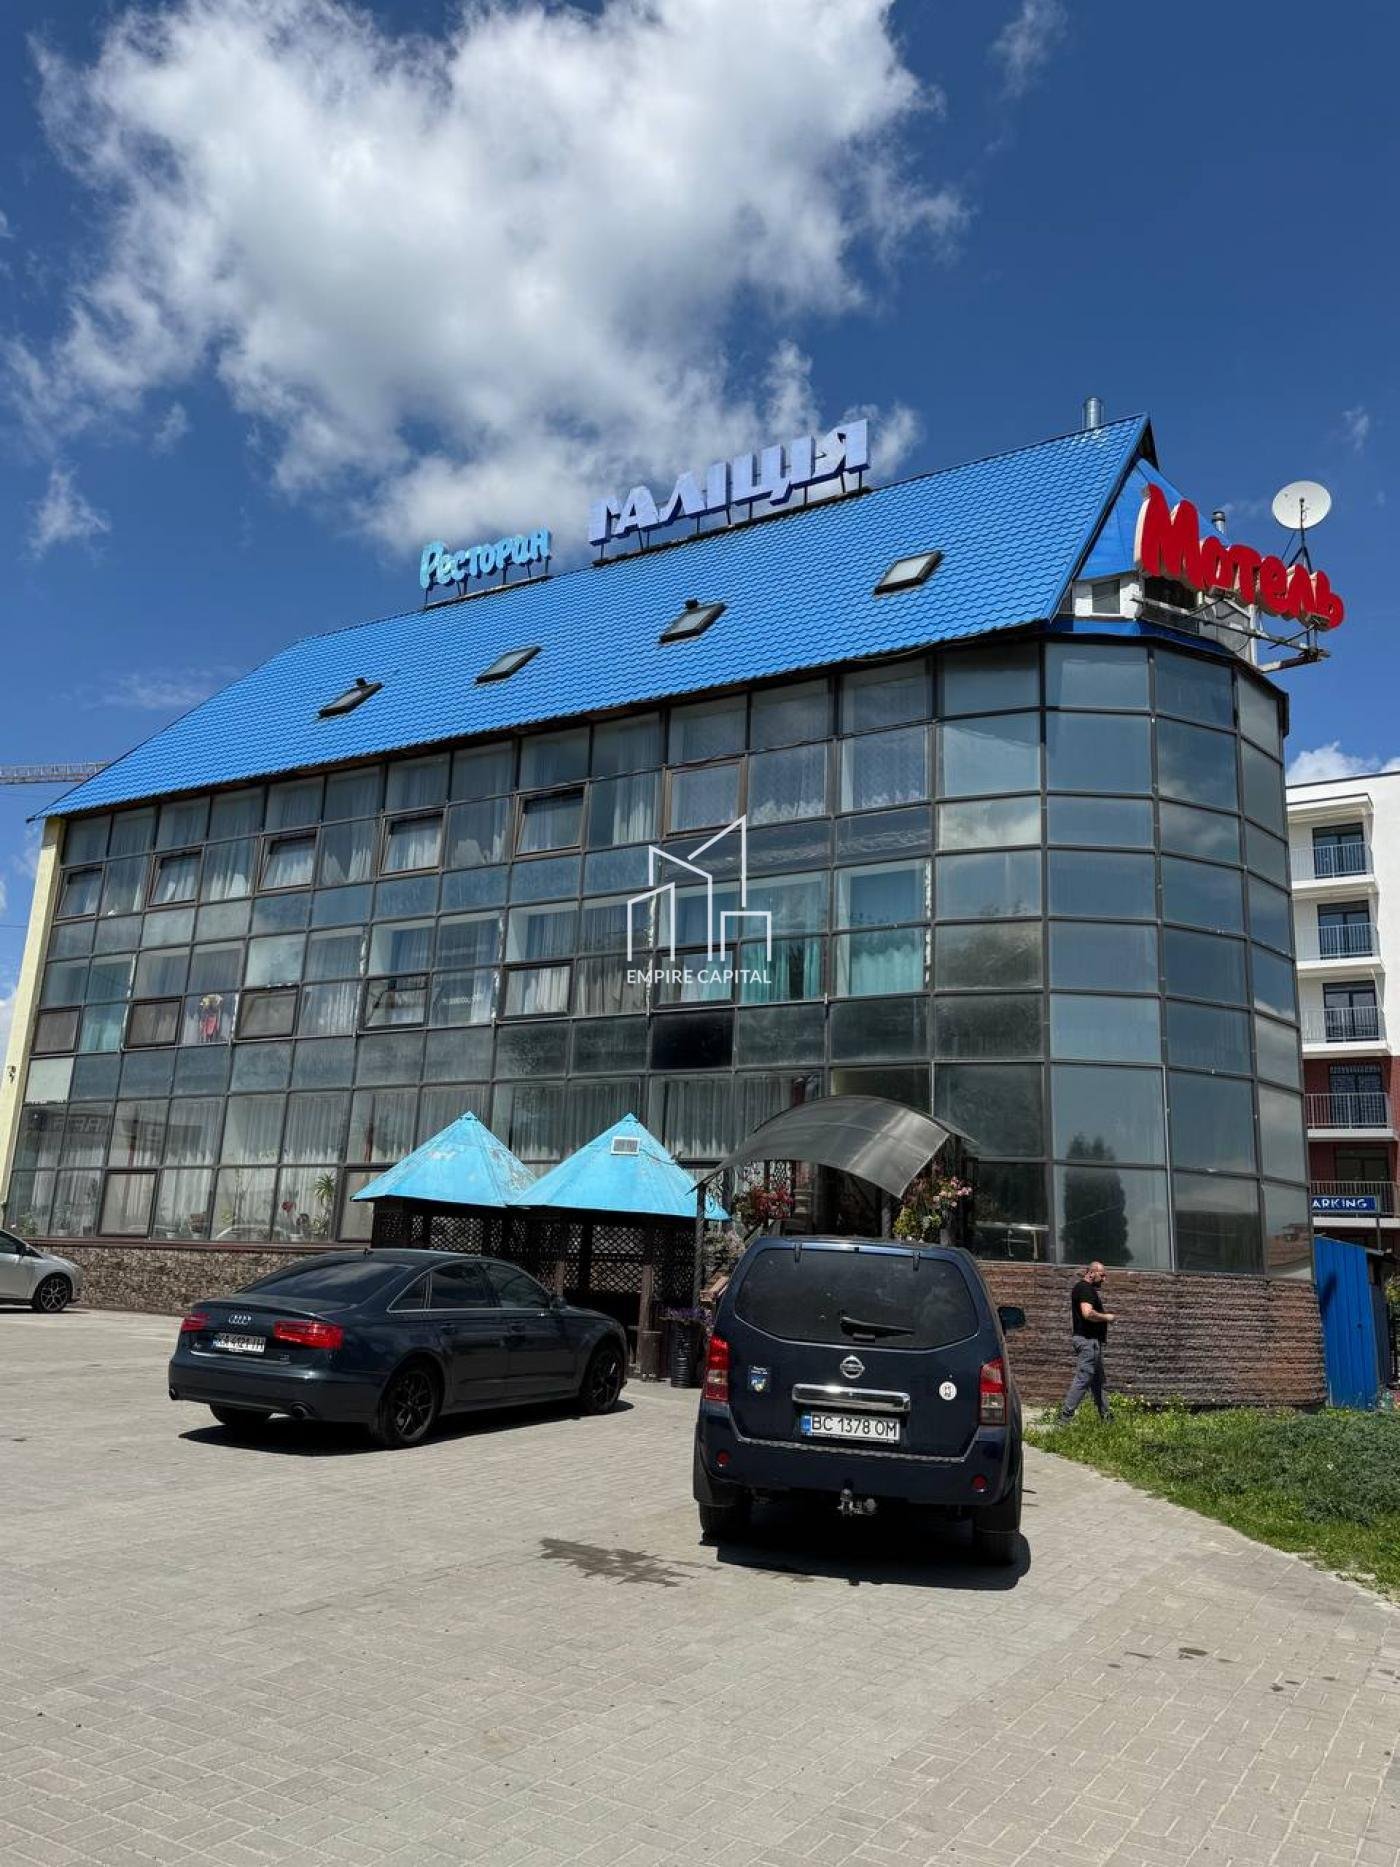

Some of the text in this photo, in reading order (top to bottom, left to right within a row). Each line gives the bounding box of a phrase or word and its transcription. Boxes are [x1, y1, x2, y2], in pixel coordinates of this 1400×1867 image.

[588, 419, 870, 545] ГАЛІЦІЯ
[419, 529, 550, 590] Ресторан
[1135, 483, 1345, 631] Мотель
[1312, 1198, 1368, 1209] ARKING
[812, 1415, 896, 1438] BC 1378 OM
